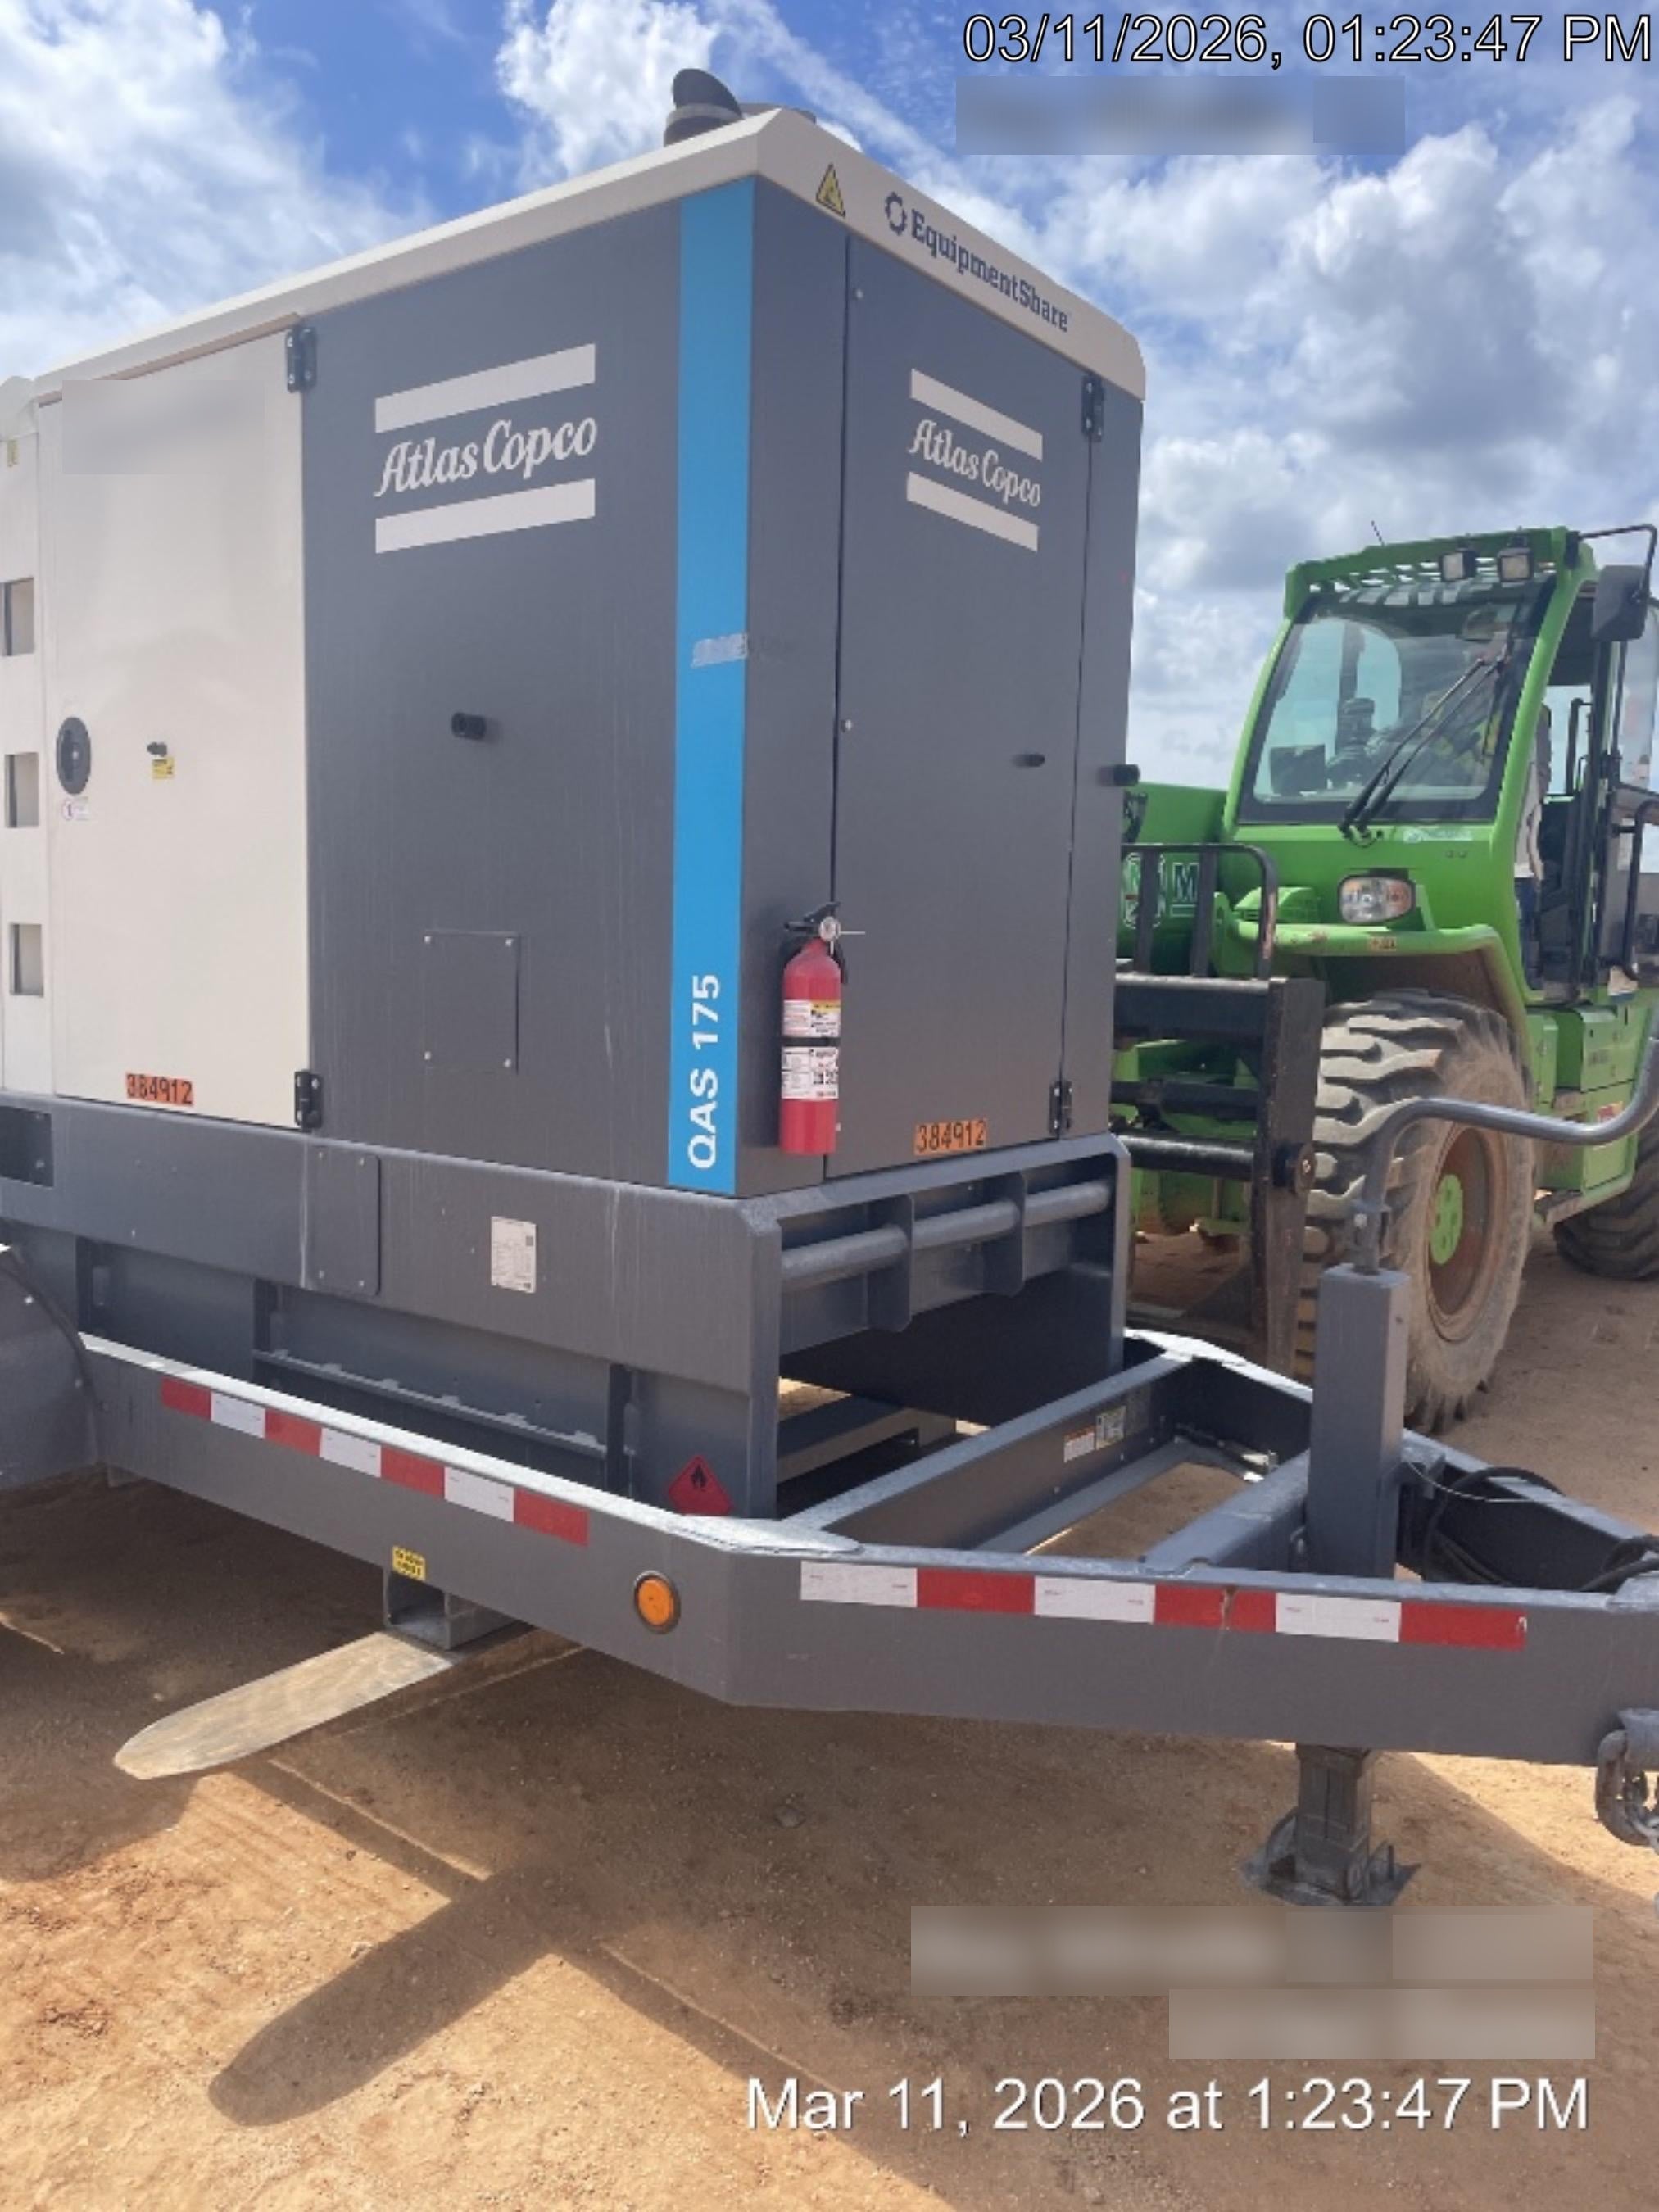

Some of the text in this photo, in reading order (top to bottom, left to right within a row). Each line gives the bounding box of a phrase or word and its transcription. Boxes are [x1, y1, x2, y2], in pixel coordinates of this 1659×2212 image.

[911, 208, 1068, 333] EquipmentShare
[373, 417, 598, 497] Atlas Copco
[908, 419, 1041, 507] Atlas Copco
[127, 1073, 193, 1105] 384912
[687, 974, 720, 1169] QAS 175
[917, 1119, 986, 1154] 384912
